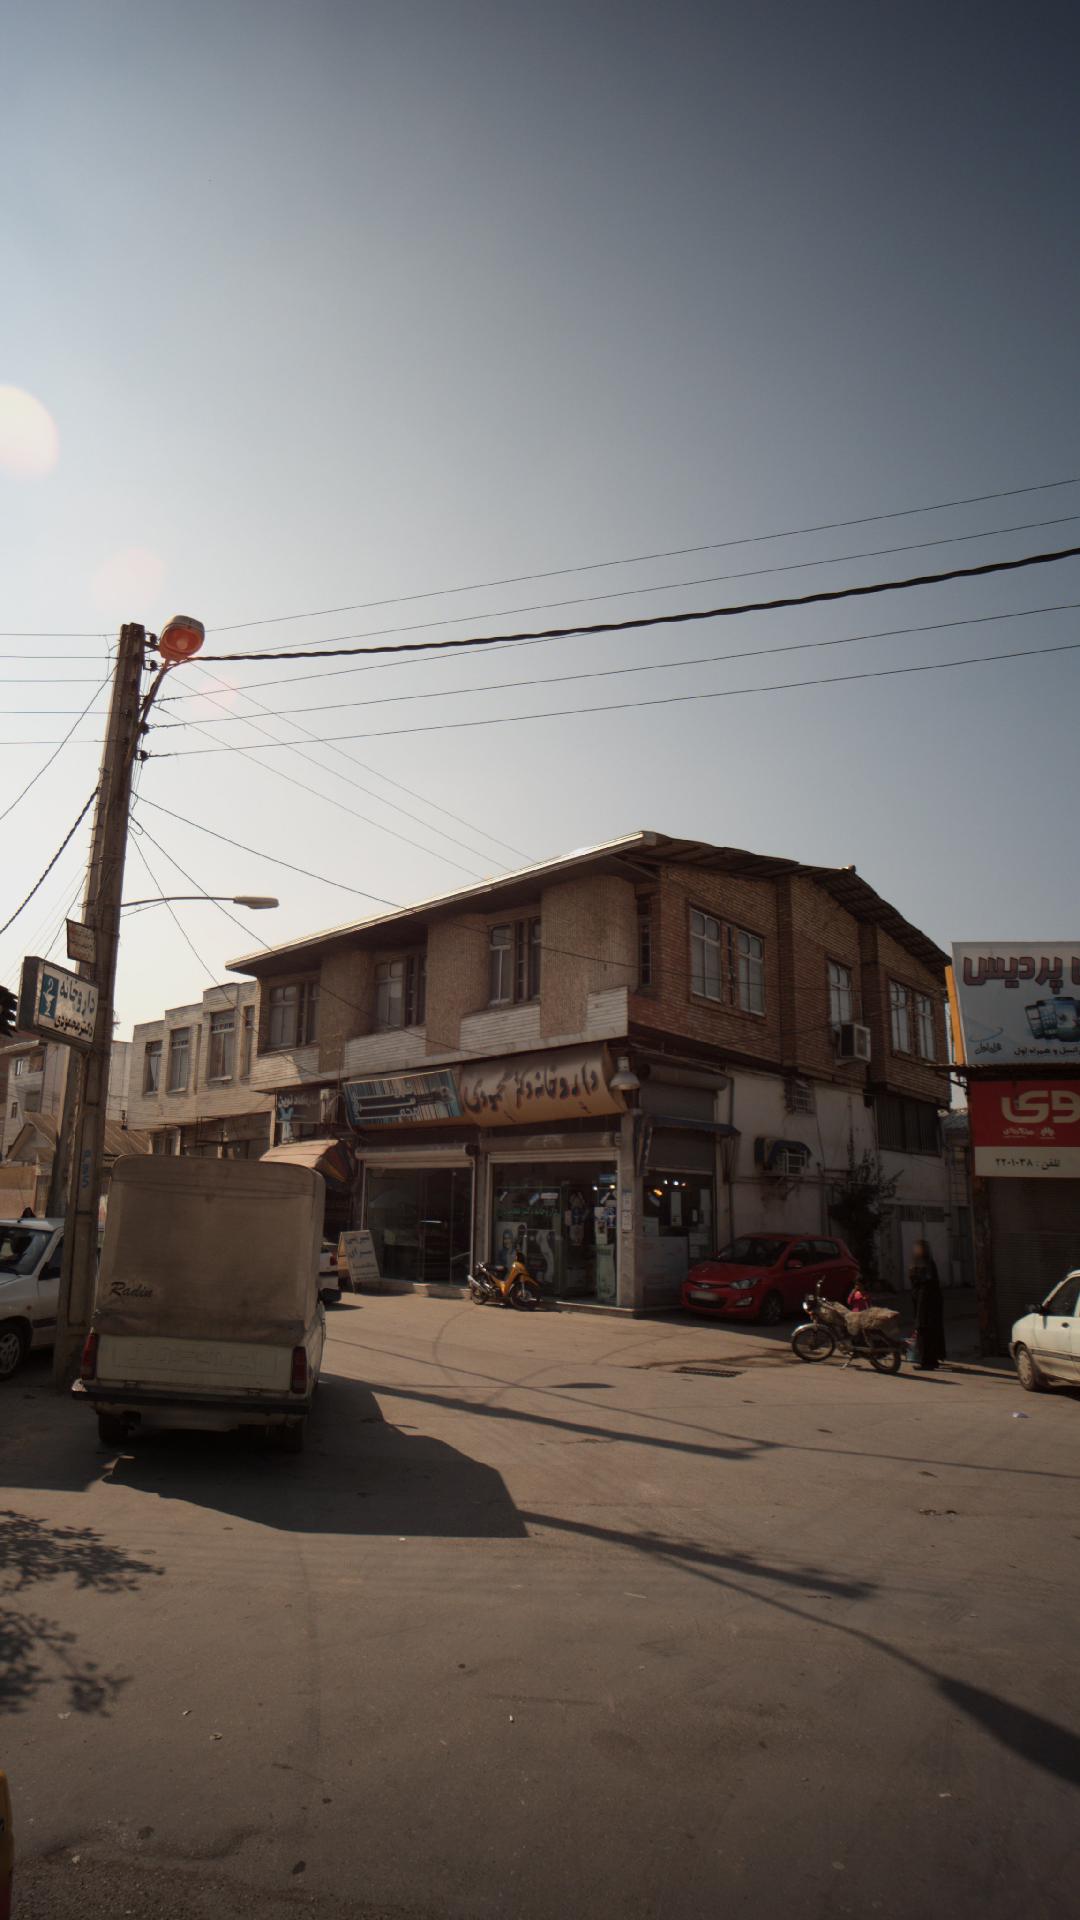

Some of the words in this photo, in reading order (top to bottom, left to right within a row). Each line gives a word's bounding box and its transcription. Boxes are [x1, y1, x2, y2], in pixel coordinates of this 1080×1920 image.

[963, 956, 1064, 994] پردیس
[59, 976, 95, 1016] داروخانه
[54, 1015, 80, 1031] محمودی
[78, 1020, 94, 1038] دکتر
[535, 1061, 599, 1100] داروخانه
[110, 1281, 153, 1299] Radin
